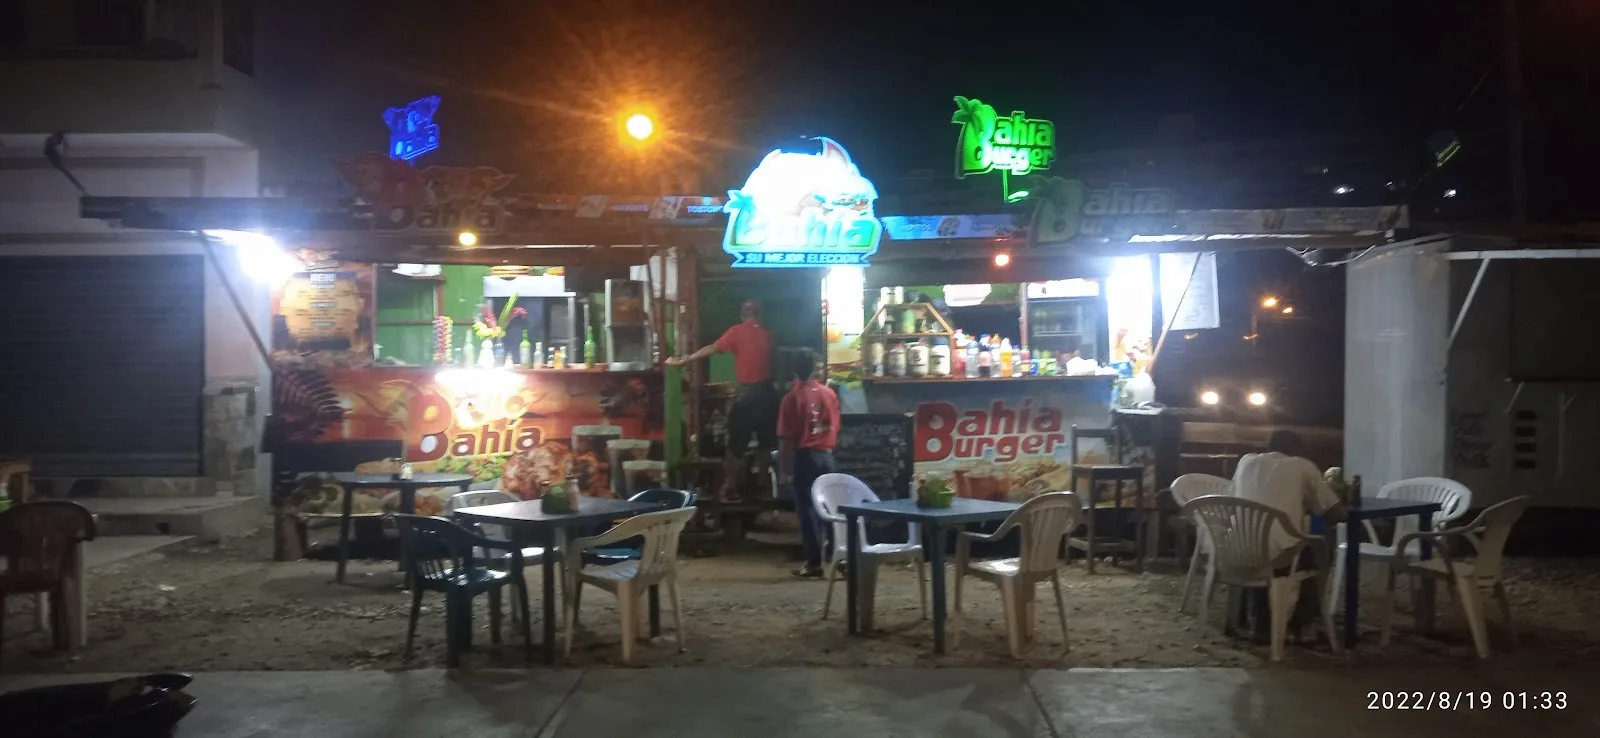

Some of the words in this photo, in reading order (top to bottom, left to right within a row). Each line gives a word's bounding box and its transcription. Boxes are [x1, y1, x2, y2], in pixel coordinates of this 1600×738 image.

[745, 253, 762, 263] SU
[764, 253, 805, 264] MEJOR
[914, 433, 1065, 462] Burger
